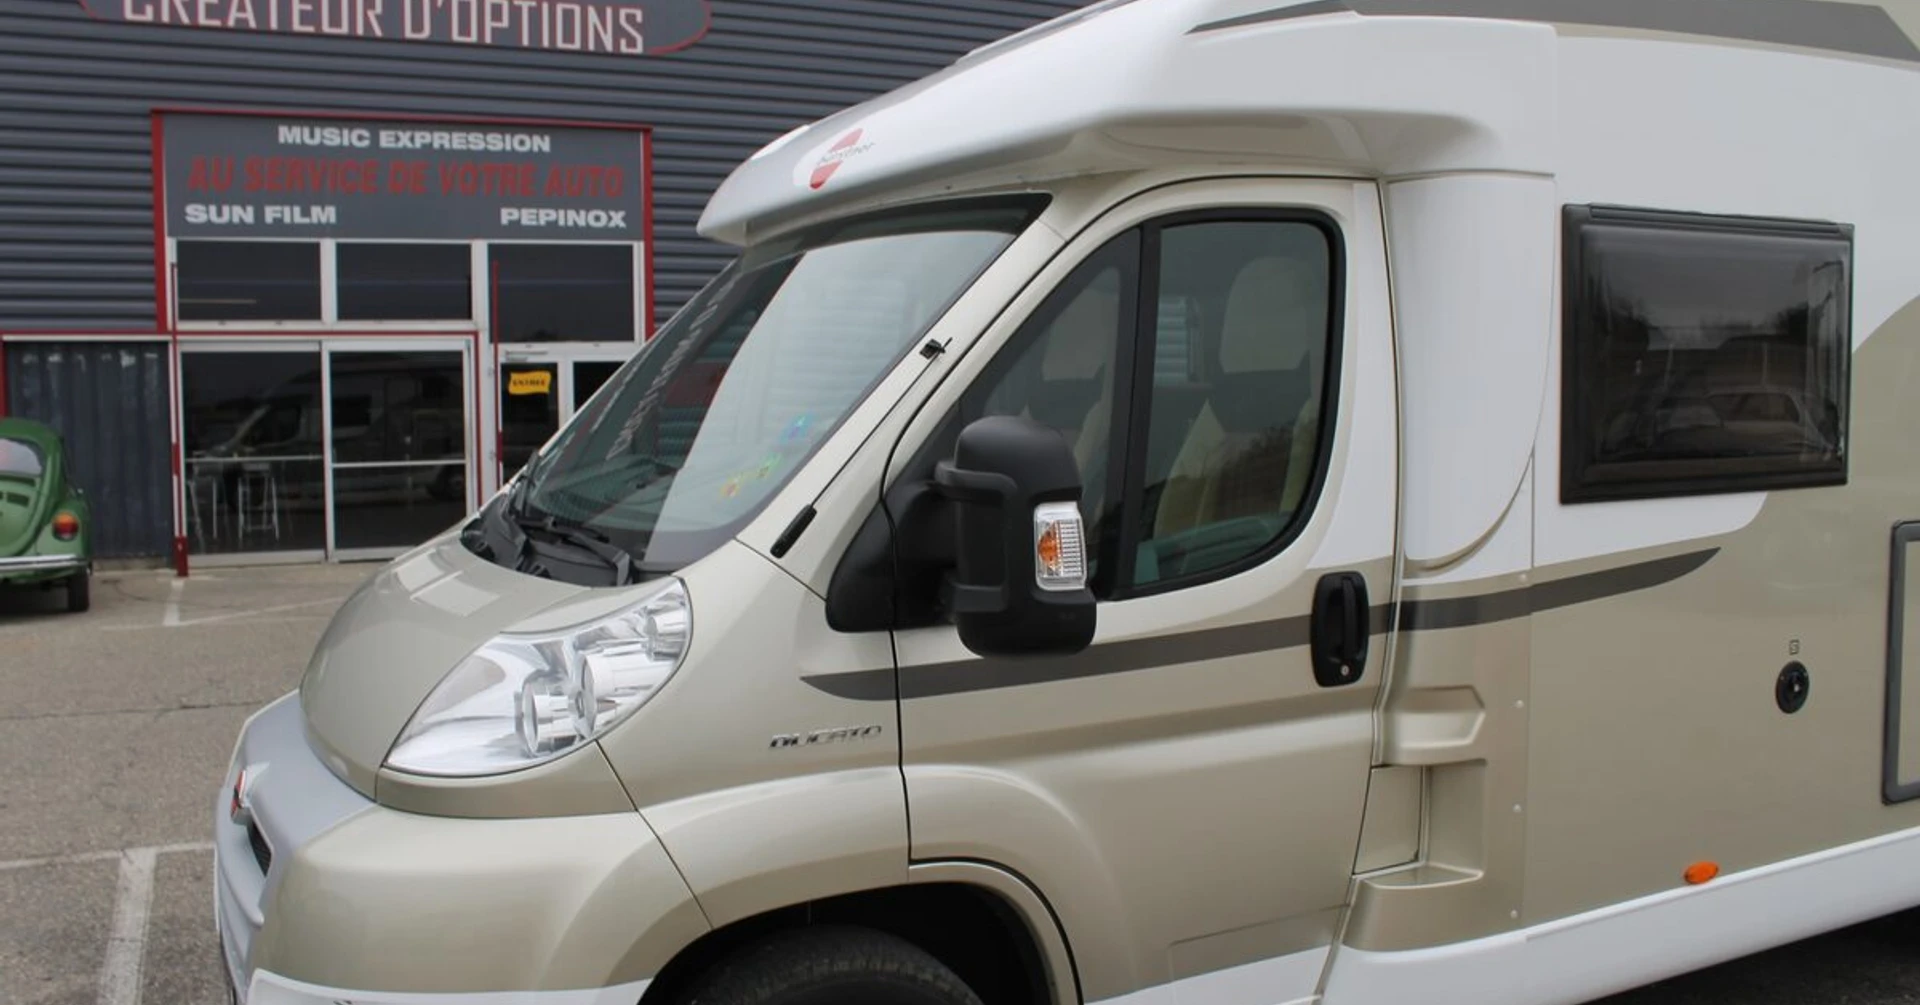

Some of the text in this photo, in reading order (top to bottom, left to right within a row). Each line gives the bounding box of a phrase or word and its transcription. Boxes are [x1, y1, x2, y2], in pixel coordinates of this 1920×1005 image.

[404, 0, 643, 54] D'OPTIONS
[278, 125, 551, 153] MUSIC EXPRESSION
[187, 154, 624, 198] AU SERVICE DE VOTRE AUTO
[185, 204, 337, 225] SUN FILM
[500, 207, 627, 229] PEPINOX
